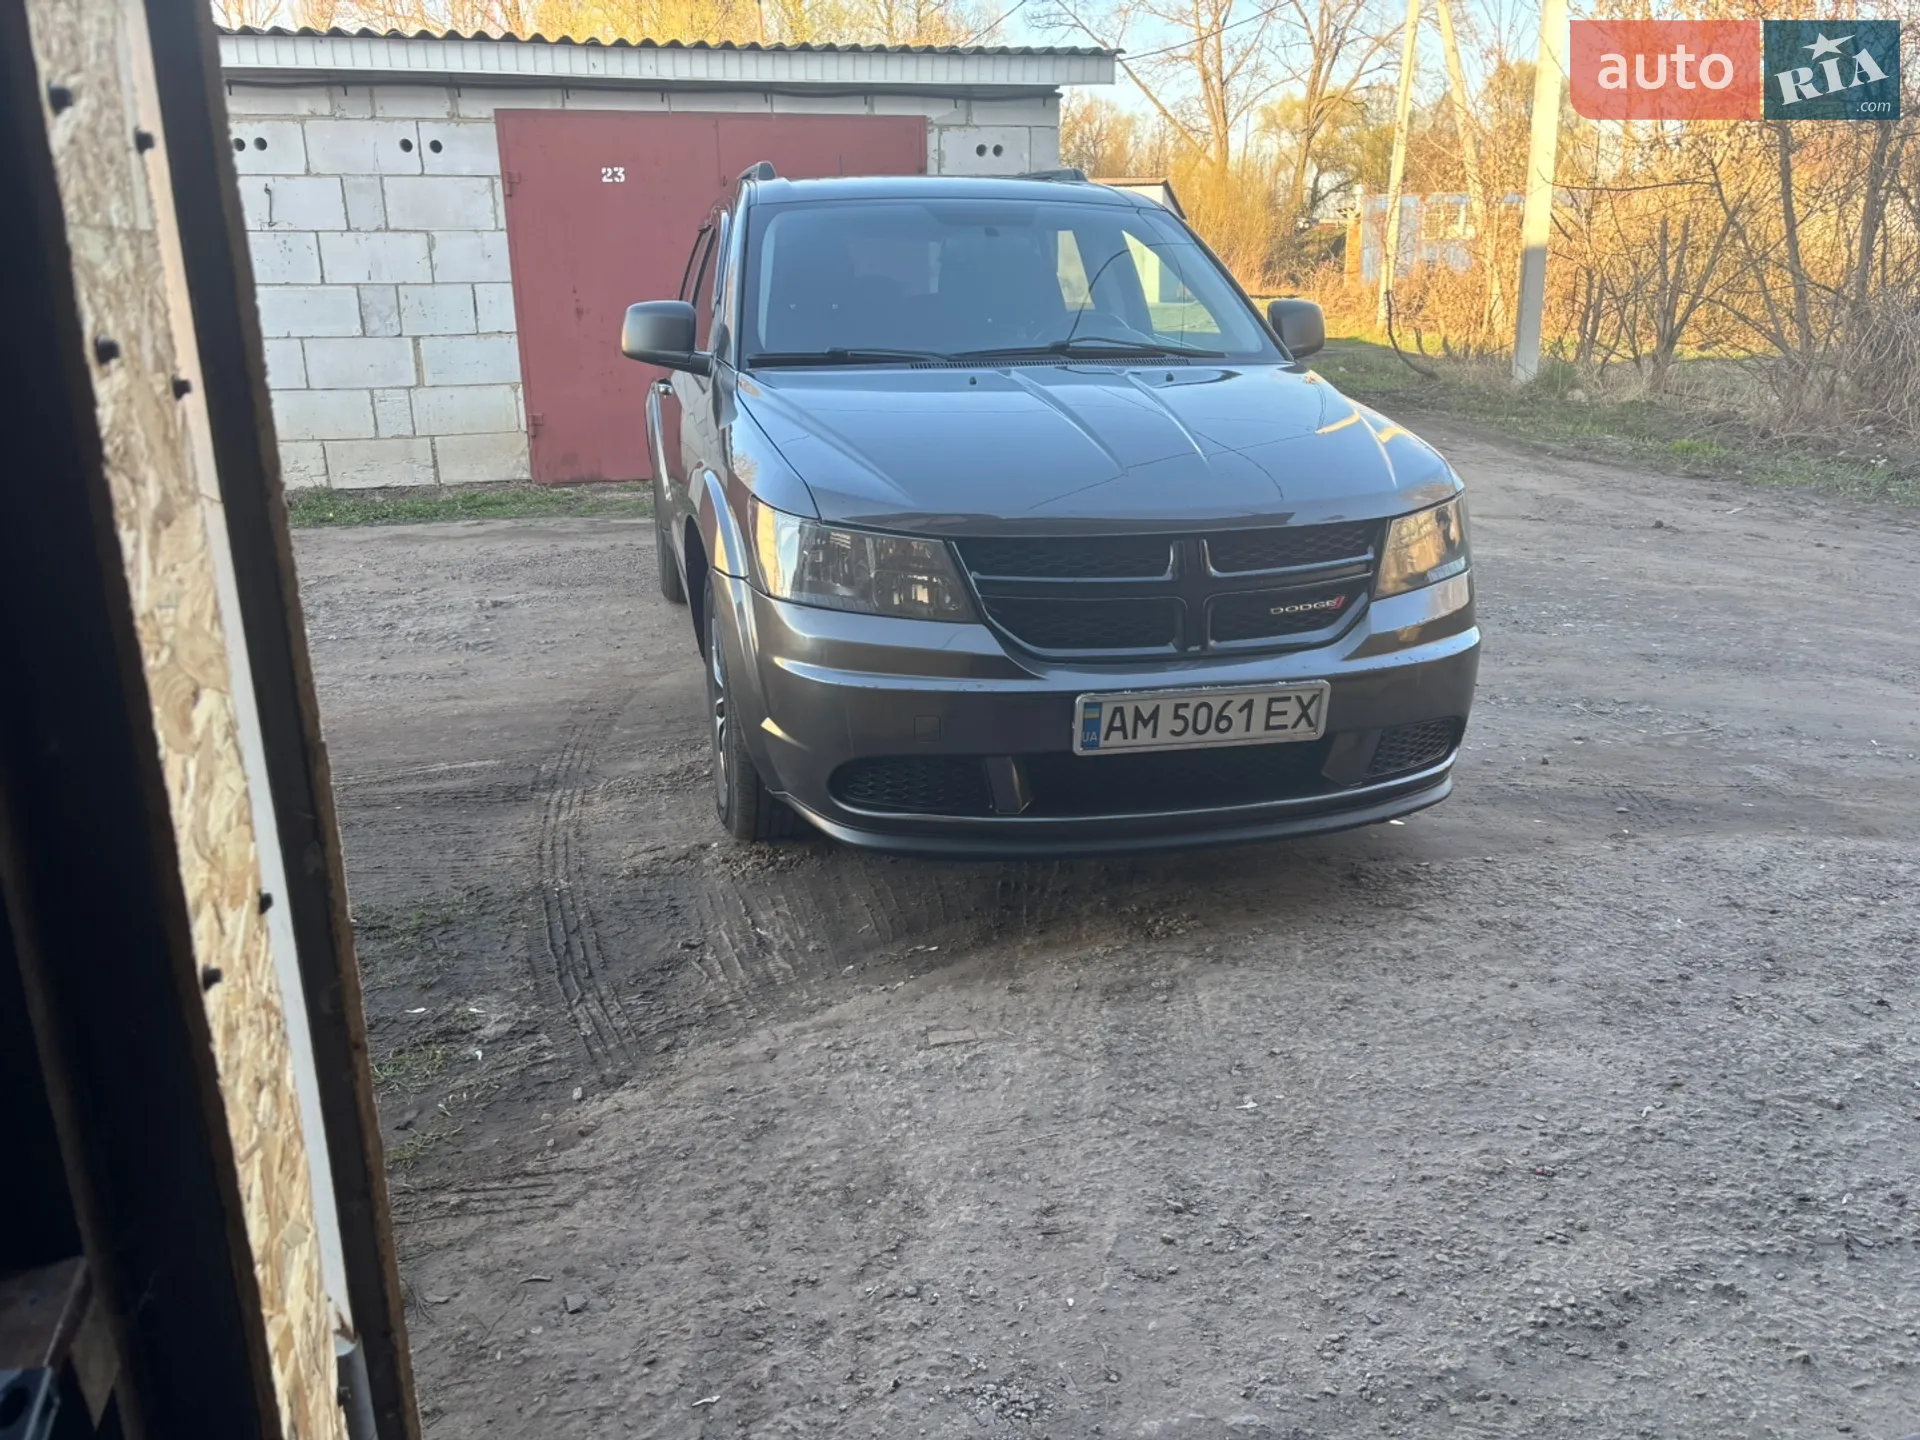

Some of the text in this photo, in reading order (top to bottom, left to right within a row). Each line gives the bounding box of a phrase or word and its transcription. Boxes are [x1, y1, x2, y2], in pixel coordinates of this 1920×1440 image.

[601, 166, 626, 183] 23
[1270, 599, 1338, 615] DODGE
[1103, 693, 1320, 741] AM 5061 EX
[1082, 731, 1098, 743] UA
